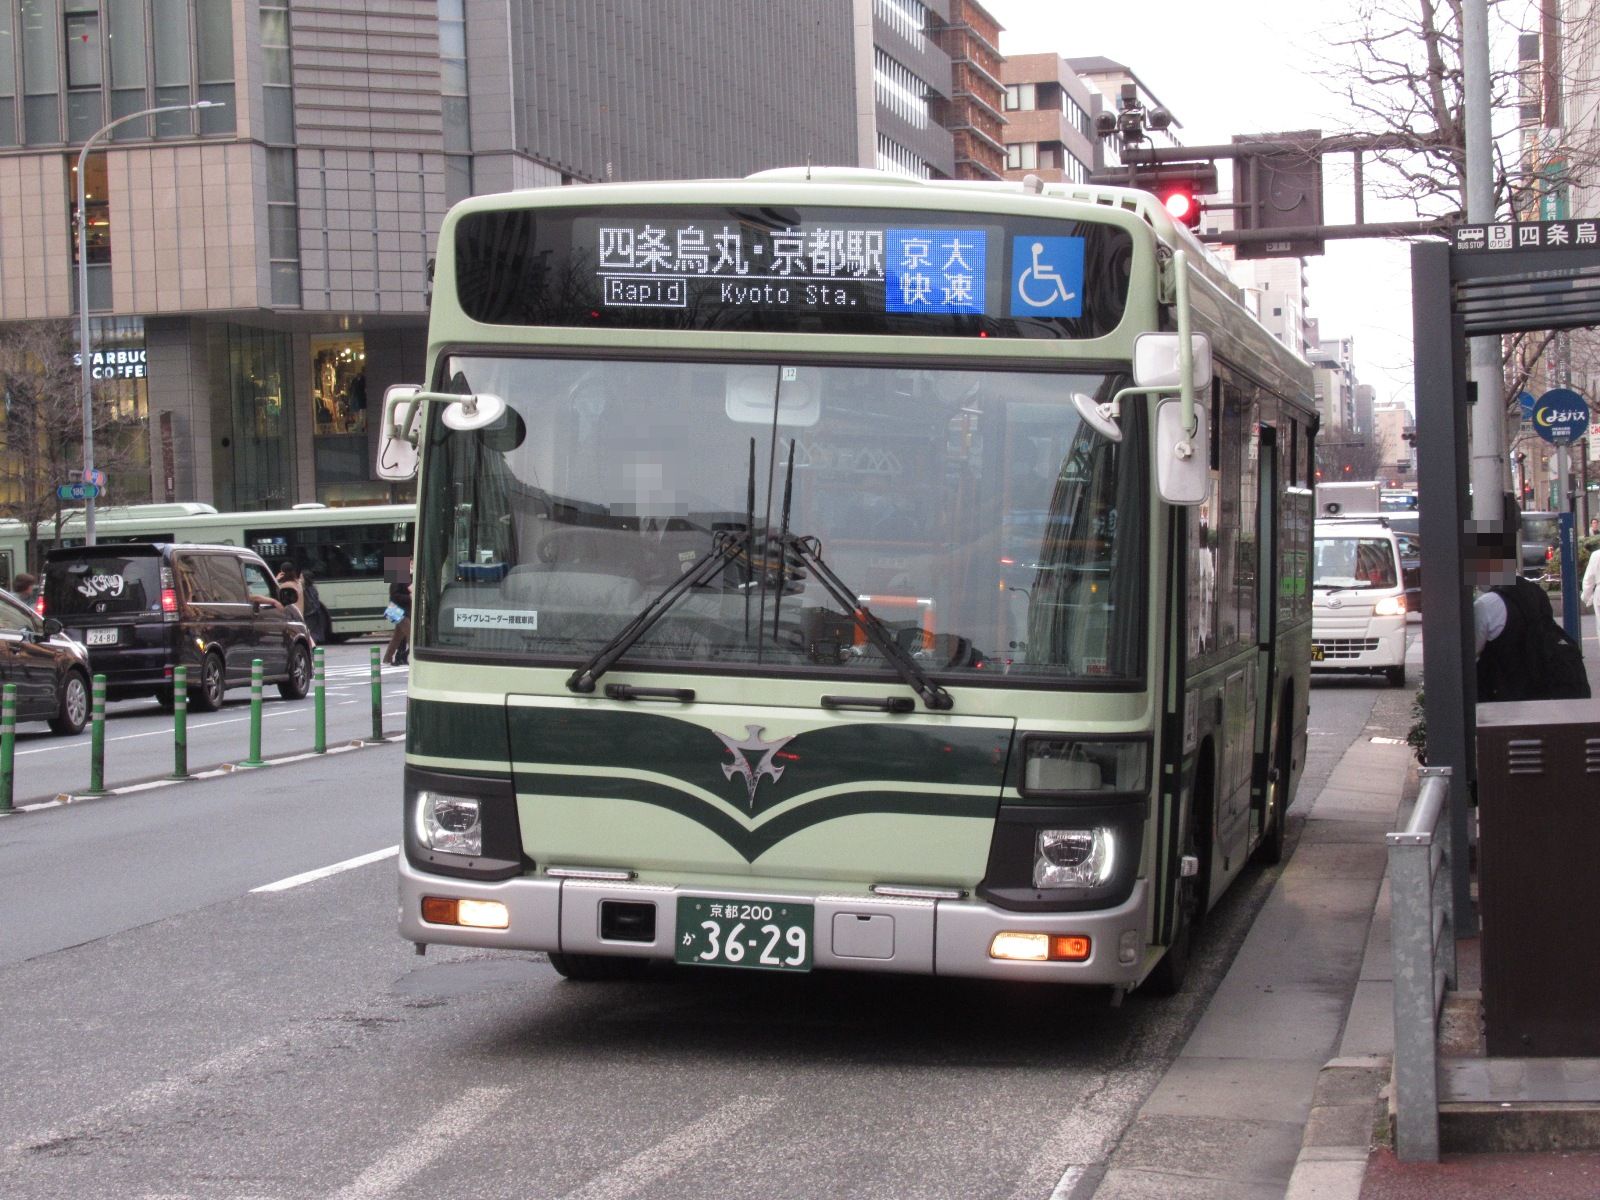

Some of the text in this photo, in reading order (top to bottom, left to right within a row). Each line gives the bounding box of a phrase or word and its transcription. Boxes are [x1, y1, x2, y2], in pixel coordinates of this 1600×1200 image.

[1489, 239, 1511, 248] のりば
[1494, 226, 1506, 240] B
[1519, 222, 1598, 247] 四条烏
[899, 237, 974, 273] 京大
[1457, 241, 1485, 250] BUS STOP
[610, 280, 680, 304] Rapid
[720, 285, 858, 306] Kyoto Sta.
[899, 273, 974, 307] 快速
[1545, 410, 1586, 423] よるバス
[456, 613, 535, 625] ドライブレコーダー搭載車両
[682, 920, 806, 966] か 36-29
